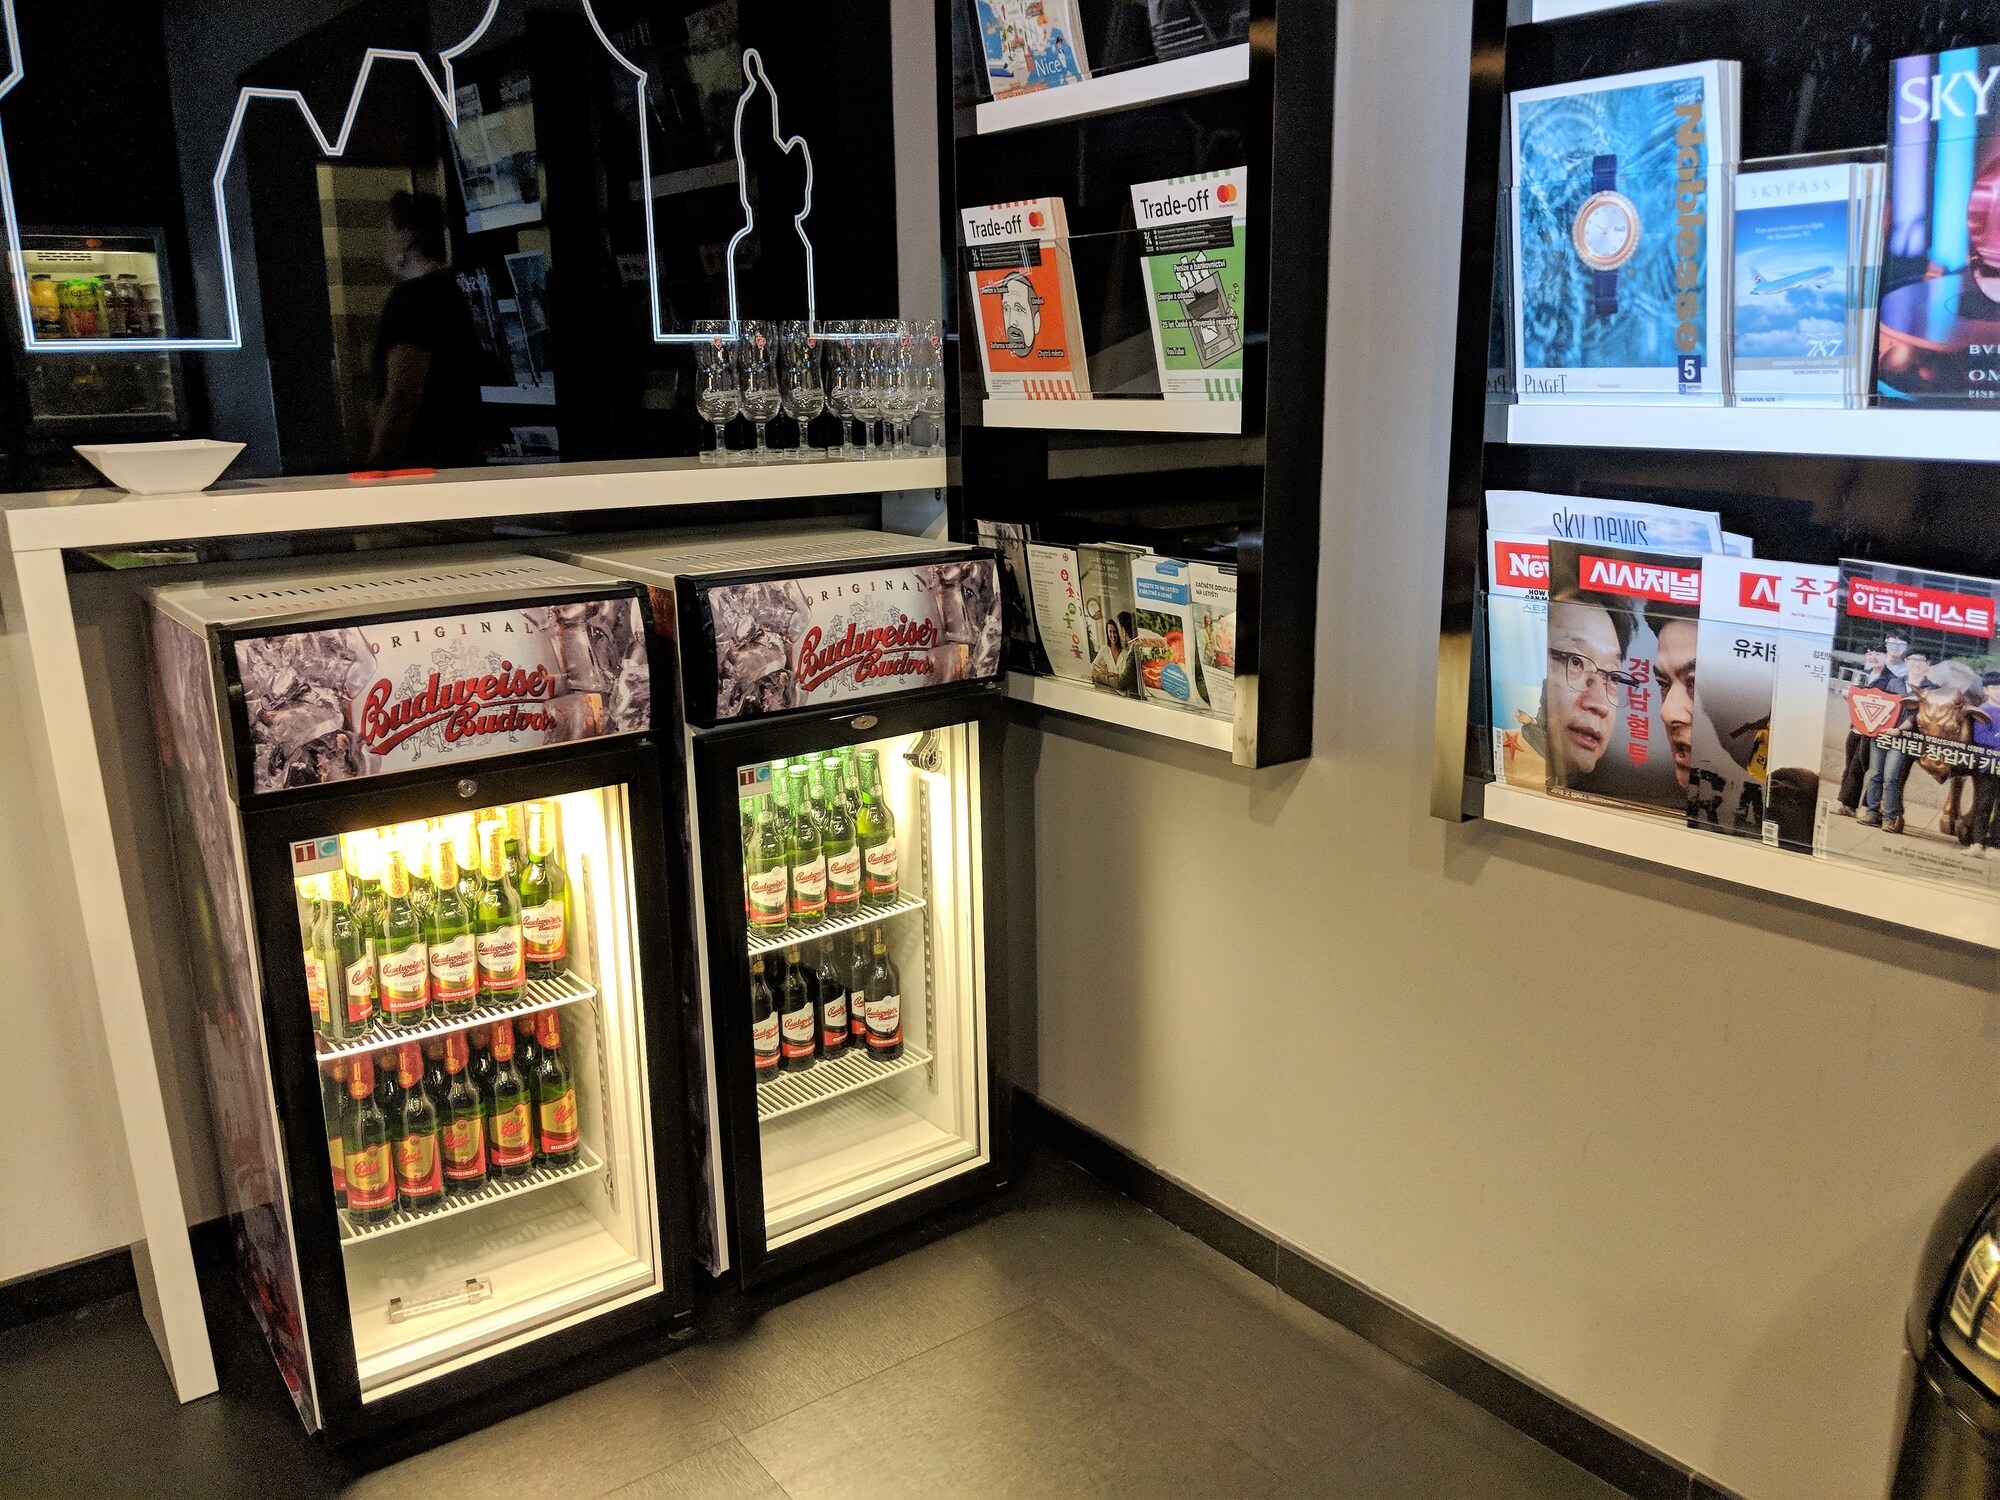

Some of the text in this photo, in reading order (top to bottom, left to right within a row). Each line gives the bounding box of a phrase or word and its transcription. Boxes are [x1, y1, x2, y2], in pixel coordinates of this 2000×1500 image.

[1035, 57, 1062, 77] Nice
[1751, 180, 1831, 199] SKYPASS
[1140, 188, 1210, 219] Trade-off
[969, 214, 1022, 239] Trade-off
[1674, 103, 1706, 352] Noblesse
[1969, 344, 2000, 355] BV
[1683, 359, 1696, 380] 5
[1524, 374, 1567, 394] PIAGET
[1594, 516, 1649, 546] news
[1195, 581, 1237, 594] ZAČNĚTE DOVOLEN
[1589, 560, 1699, 601] 시사저널
[806, 580, 923, 607] ORIGINAL
[1203, 590, 1219, 599] LETIŠTI
[1853, 591, 1989, 632] 이코노미스트
[370, 621, 534, 655] ORIGINAL
[796, 613, 939, 685] Budweiser
[360, 660, 557, 745] Budweiser
[1875, 733, 1923, 758] 준비된
[1926, 744, 1977, 771] 창업자
[831, 859, 860, 874] Budwei
[868, 848, 897, 865] Budweis
[796, 869, 826, 884] Budwei
[390, 997, 428, 1008] BUDWEIS
[785, 1014, 814, 1030] Budweis
[501, 1117, 526, 1137] Bud
[550, 1139, 579, 1150] BUDWEI
